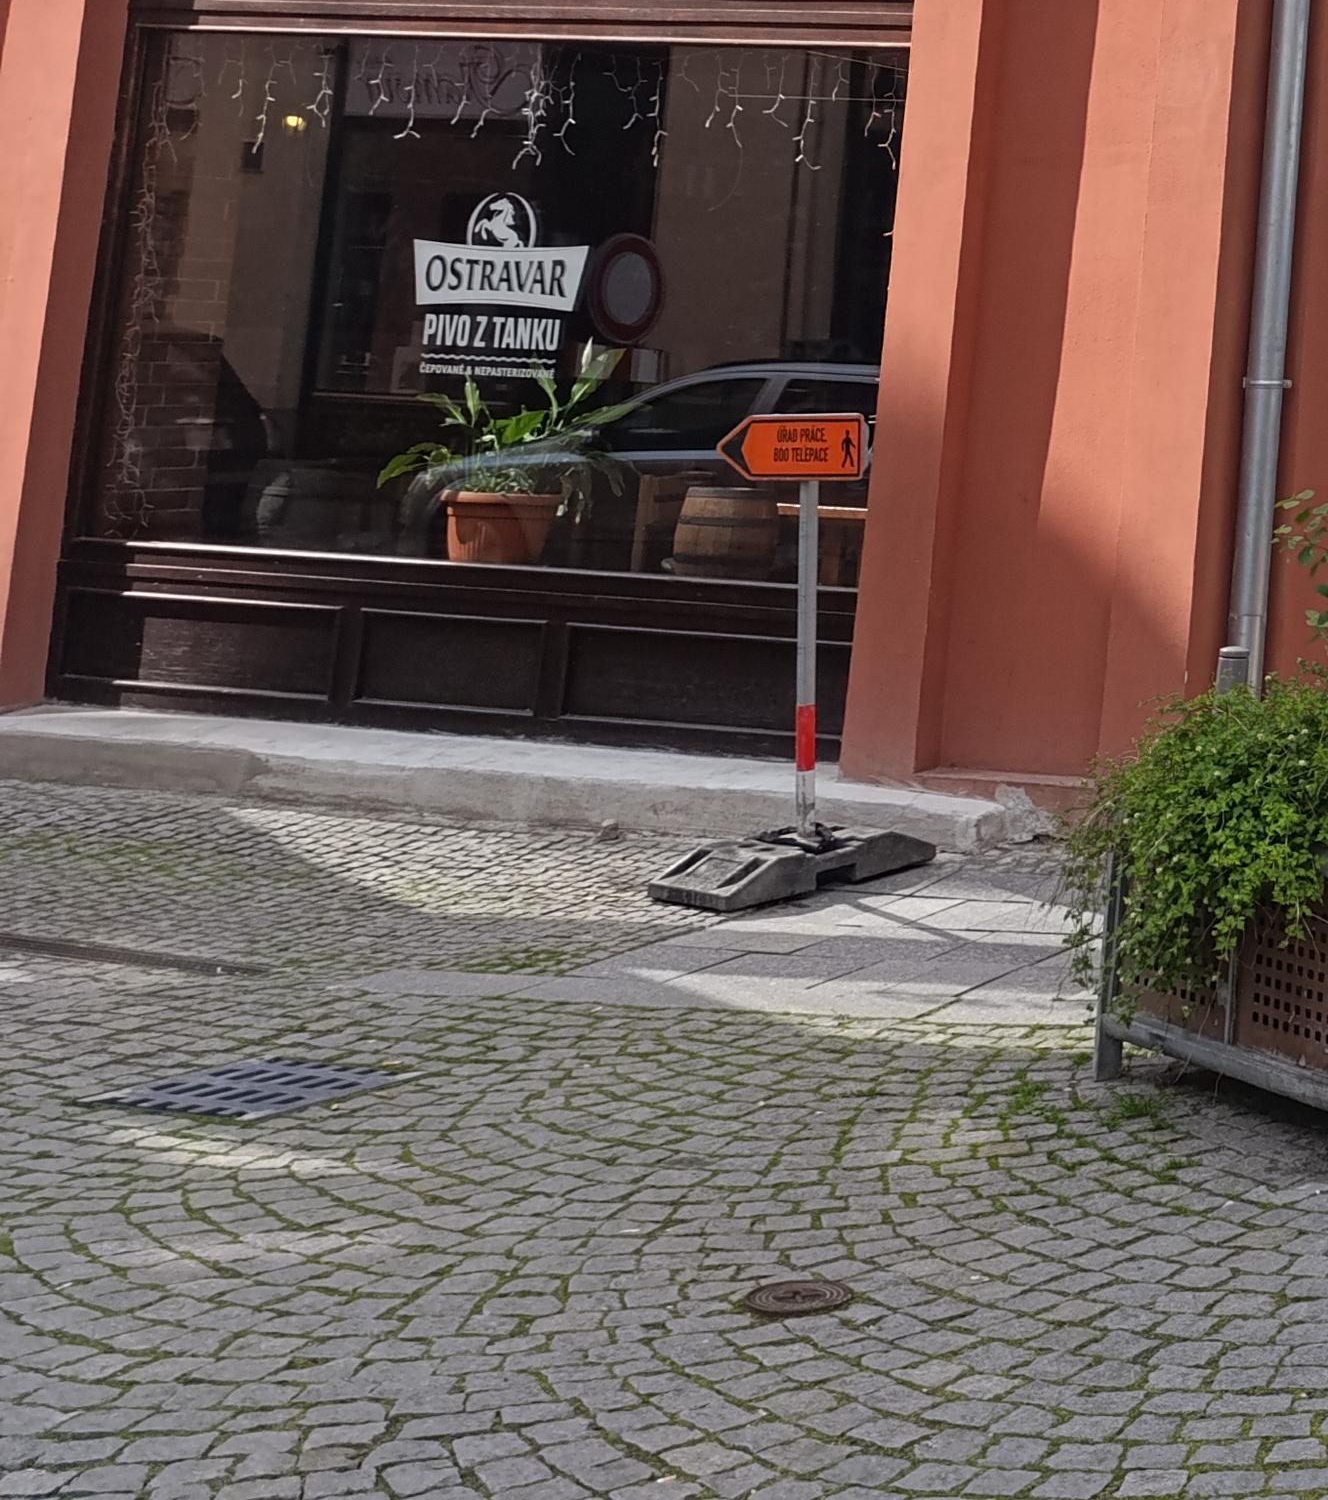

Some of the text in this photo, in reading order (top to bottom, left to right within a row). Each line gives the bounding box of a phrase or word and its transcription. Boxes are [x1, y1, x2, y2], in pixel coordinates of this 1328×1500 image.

[425, 254, 568, 298] OSTRAVAR
[422, 313, 561, 352] PIVO Z TANKU
[419, 361, 464, 376] ČEPOVANÉ
